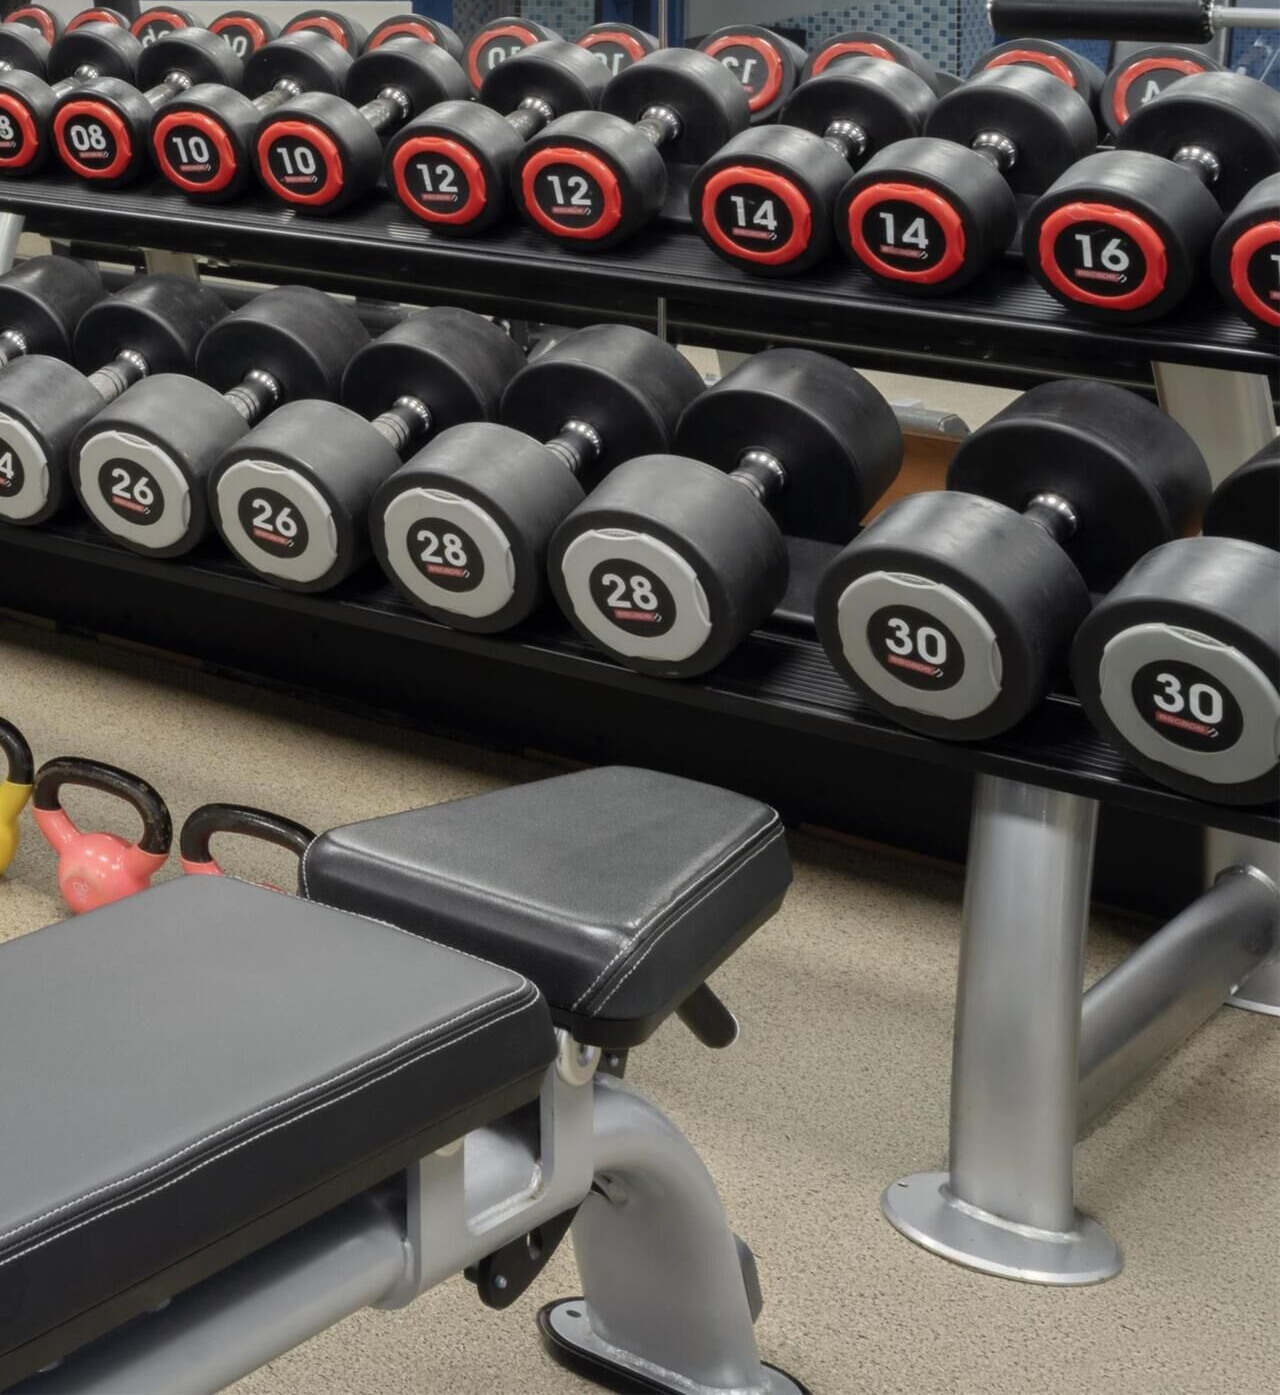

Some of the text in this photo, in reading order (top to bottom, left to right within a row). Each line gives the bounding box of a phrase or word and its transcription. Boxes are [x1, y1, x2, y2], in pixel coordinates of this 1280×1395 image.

[70, 124, 107, 151] 08
[172, 136, 210, 163] 10
[276, 146, 316, 175] 10
[416, 163, 459, 193] 12
[547, 175, 592, 206] 12
[730, 195, 778, 231] 14
[879, 212, 929, 249] 14
[1075, 234, 1130, 272] 16
[111, 468, 155, 506] 26
[251, 497, 298, 539] 26
[416, 529, 469, 568] 28
[600, 572, 660, 612] 28
[885, 616, 948, 666] 30
[1153, 672, 1224, 725] 30
